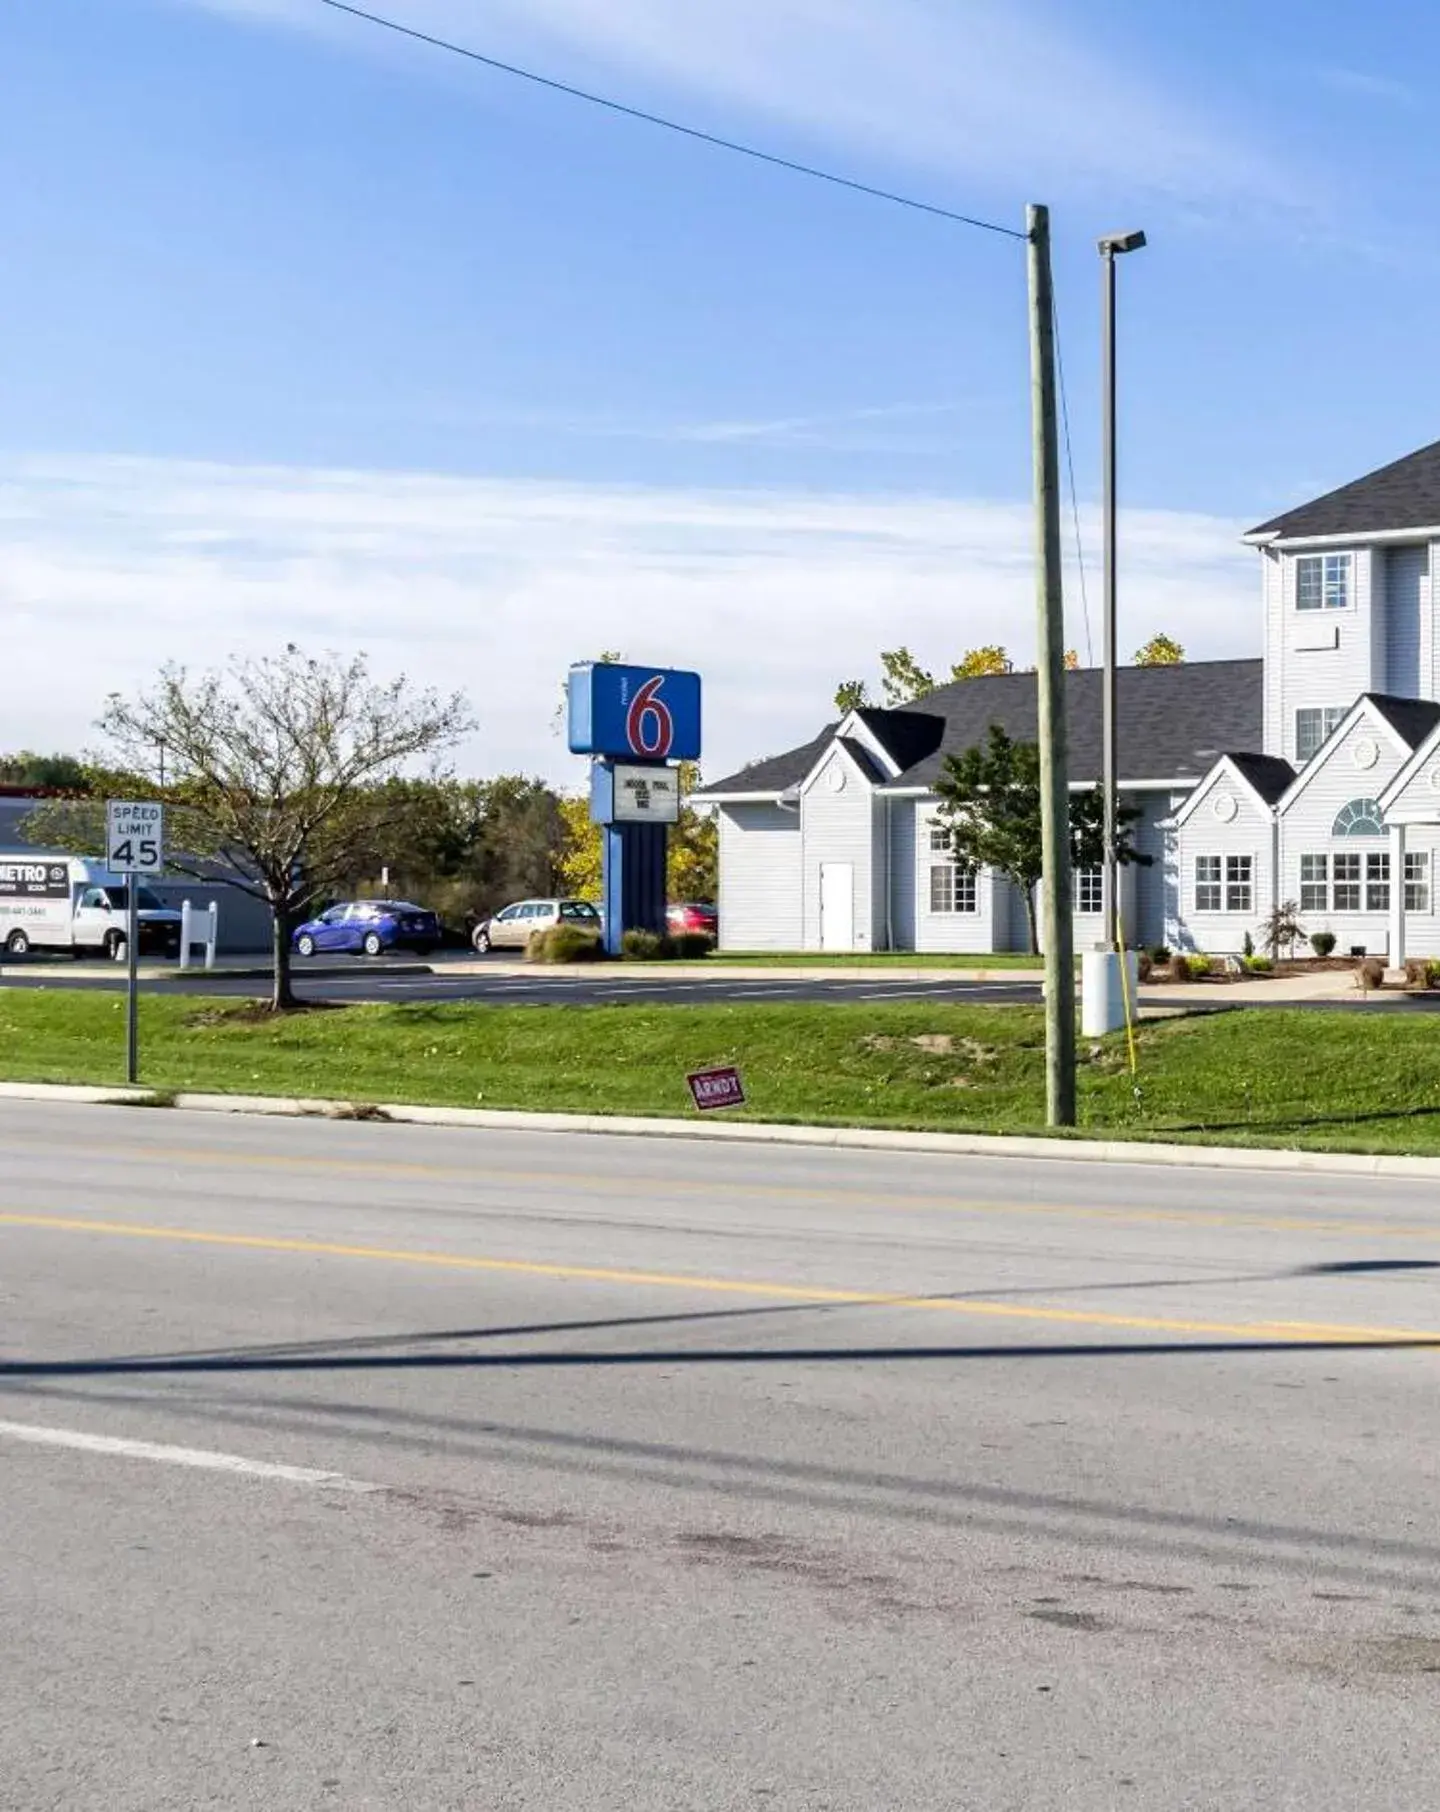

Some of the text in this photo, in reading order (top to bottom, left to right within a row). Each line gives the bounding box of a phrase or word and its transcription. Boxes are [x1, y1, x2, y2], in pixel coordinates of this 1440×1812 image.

[626, 675, 674, 758] 6
[113, 806, 159, 820] SPEED
[117, 822, 153, 837] LIMIT
[112, 840, 158, 866] 45
